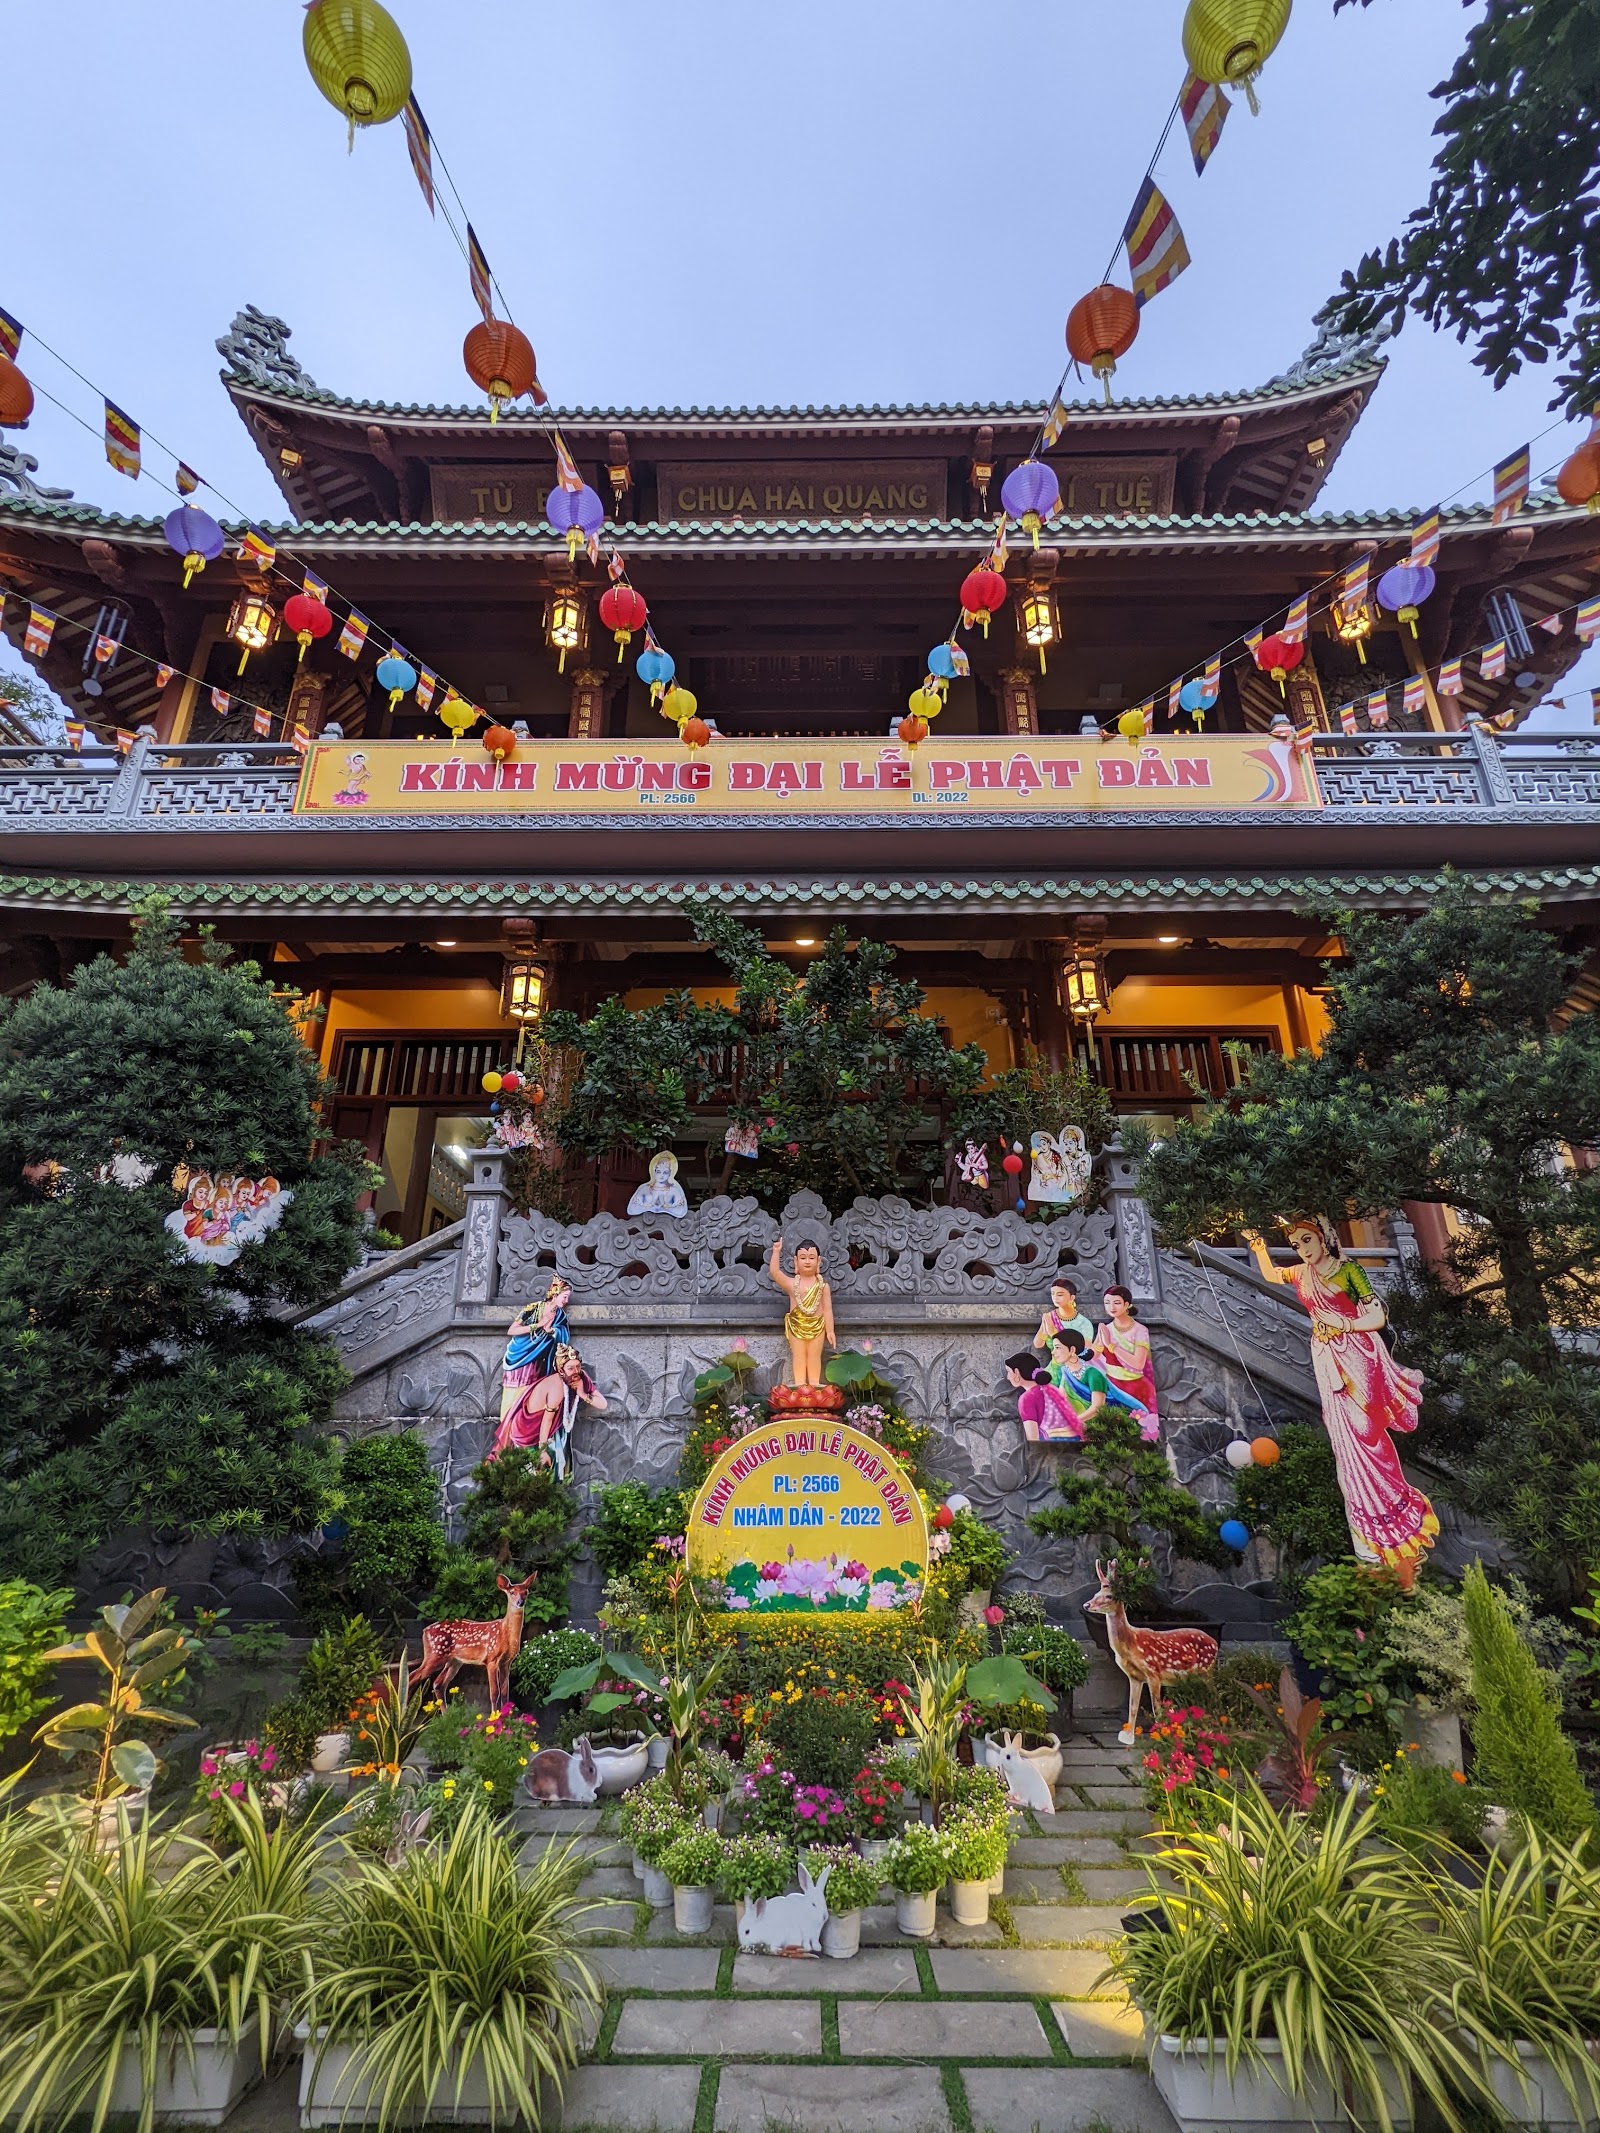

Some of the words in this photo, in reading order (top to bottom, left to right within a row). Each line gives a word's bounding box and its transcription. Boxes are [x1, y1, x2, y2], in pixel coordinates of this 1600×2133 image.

[822, 483, 928, 514] QUANG
[1094, 475, 1153, 513] TUỆ
[400, 757, 539, 792] KÍNH
[554, 755, 713, 792] MỪNG
[729, 761, 824, 798] ĐẠI
[841, 748, 913, 791] LỄ
[929, 752, 1082, 797] PHẬT
[1097, 747, 1213, 788] ĐẢN
[640, 793, 660, 804] PL:
[663, 793, 696, 804] 2566
[912, 792, 932, 803] DL:
[936, 791, 969, 803] 2022
[701, 1476, 737, 1527] KÍNH
[729, 1436, 782, 1484] MỪNG
[783, 1431, 816, 1457] ĐẠI
[820, 1429, 845, 1456] LỄ
[843, 1443, 891, 1485] PHẬT
[880, 1480, 914, 1527] ĐẢN
[773, 1475, 797, 1493] PL:
[802, 1475, 840, 1493] 2566
[733, 1503, 784, 1527] NHÂM
[789, 1501, 824, 1527] DẦN
[840, 1506, 881, 1527] 2022
